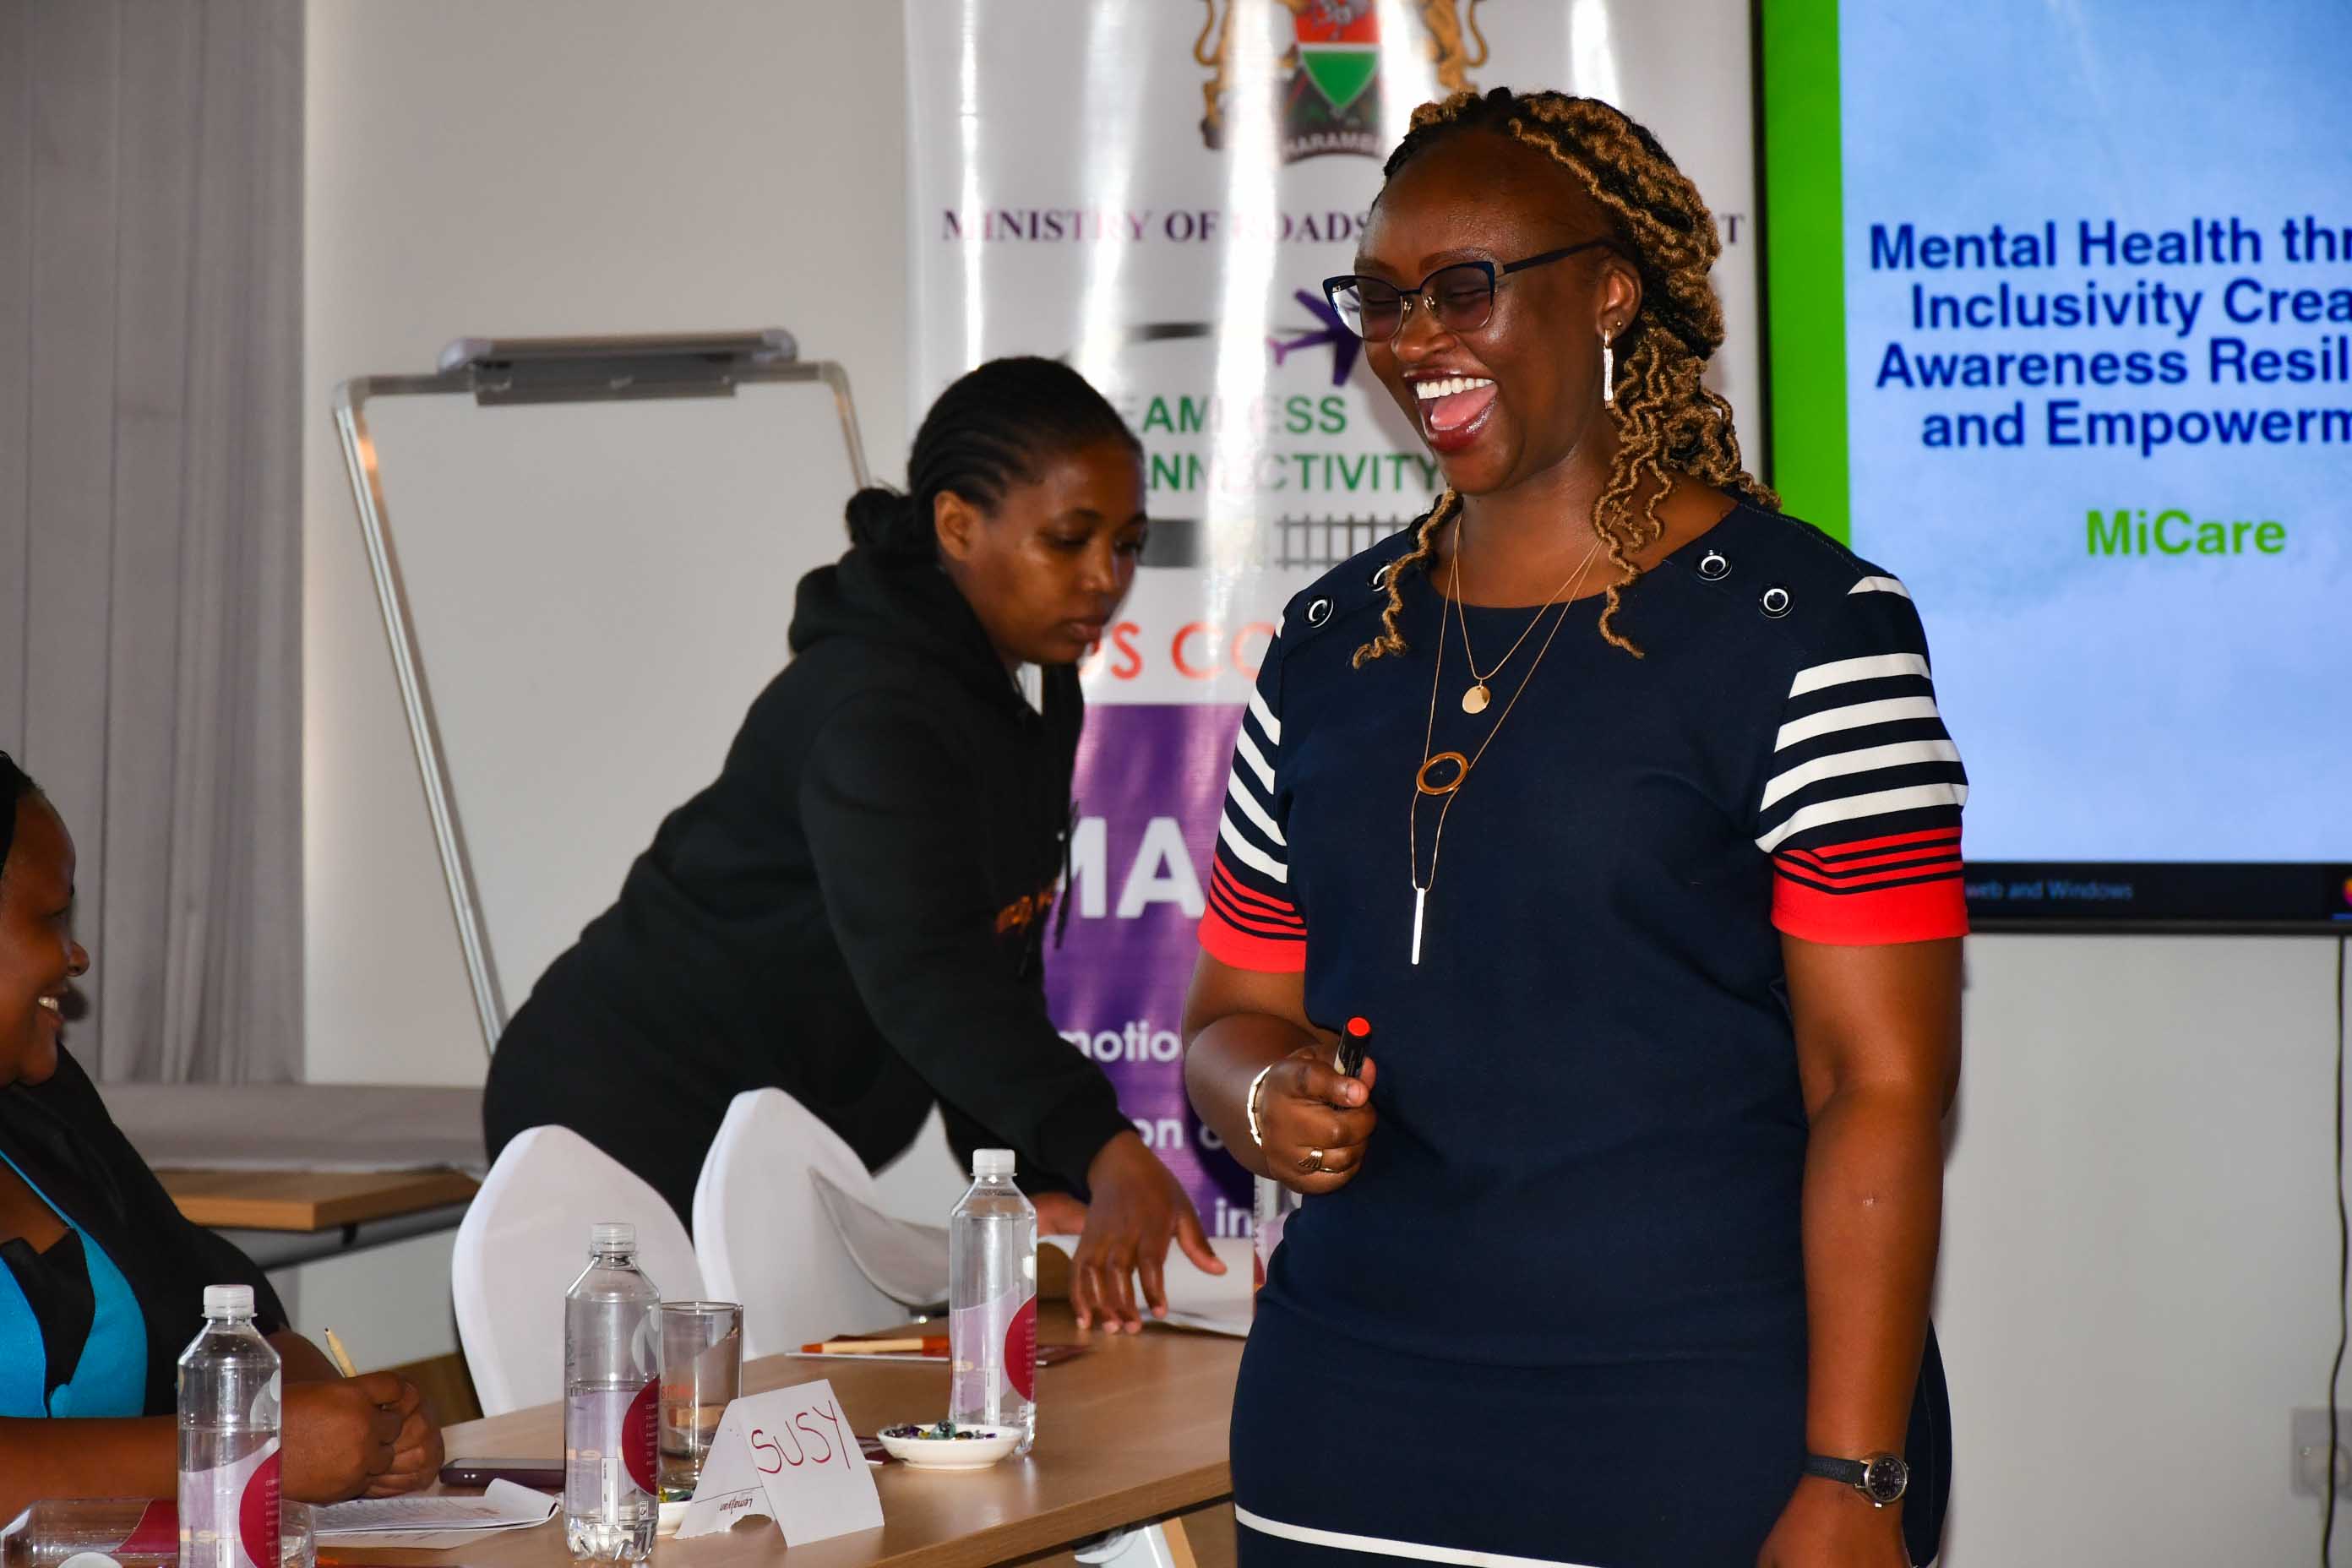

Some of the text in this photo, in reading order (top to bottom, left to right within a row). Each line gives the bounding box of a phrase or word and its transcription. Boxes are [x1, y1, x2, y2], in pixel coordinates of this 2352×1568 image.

[1164, 210, 1219, 243] OF
[1869, 220, 2056, 270] Mental
[2078, 217, 2262, 267] Health
[1912, 277, 2352, 338] Inclusivity Crea
[1875, 335, 2349, 389] Awareness Resil
[1921, 399, 2352, 457] and Empowerm
[2085, 509, 2286, 557] MiCare
[751, 1400, 851, 1473] SUSY
